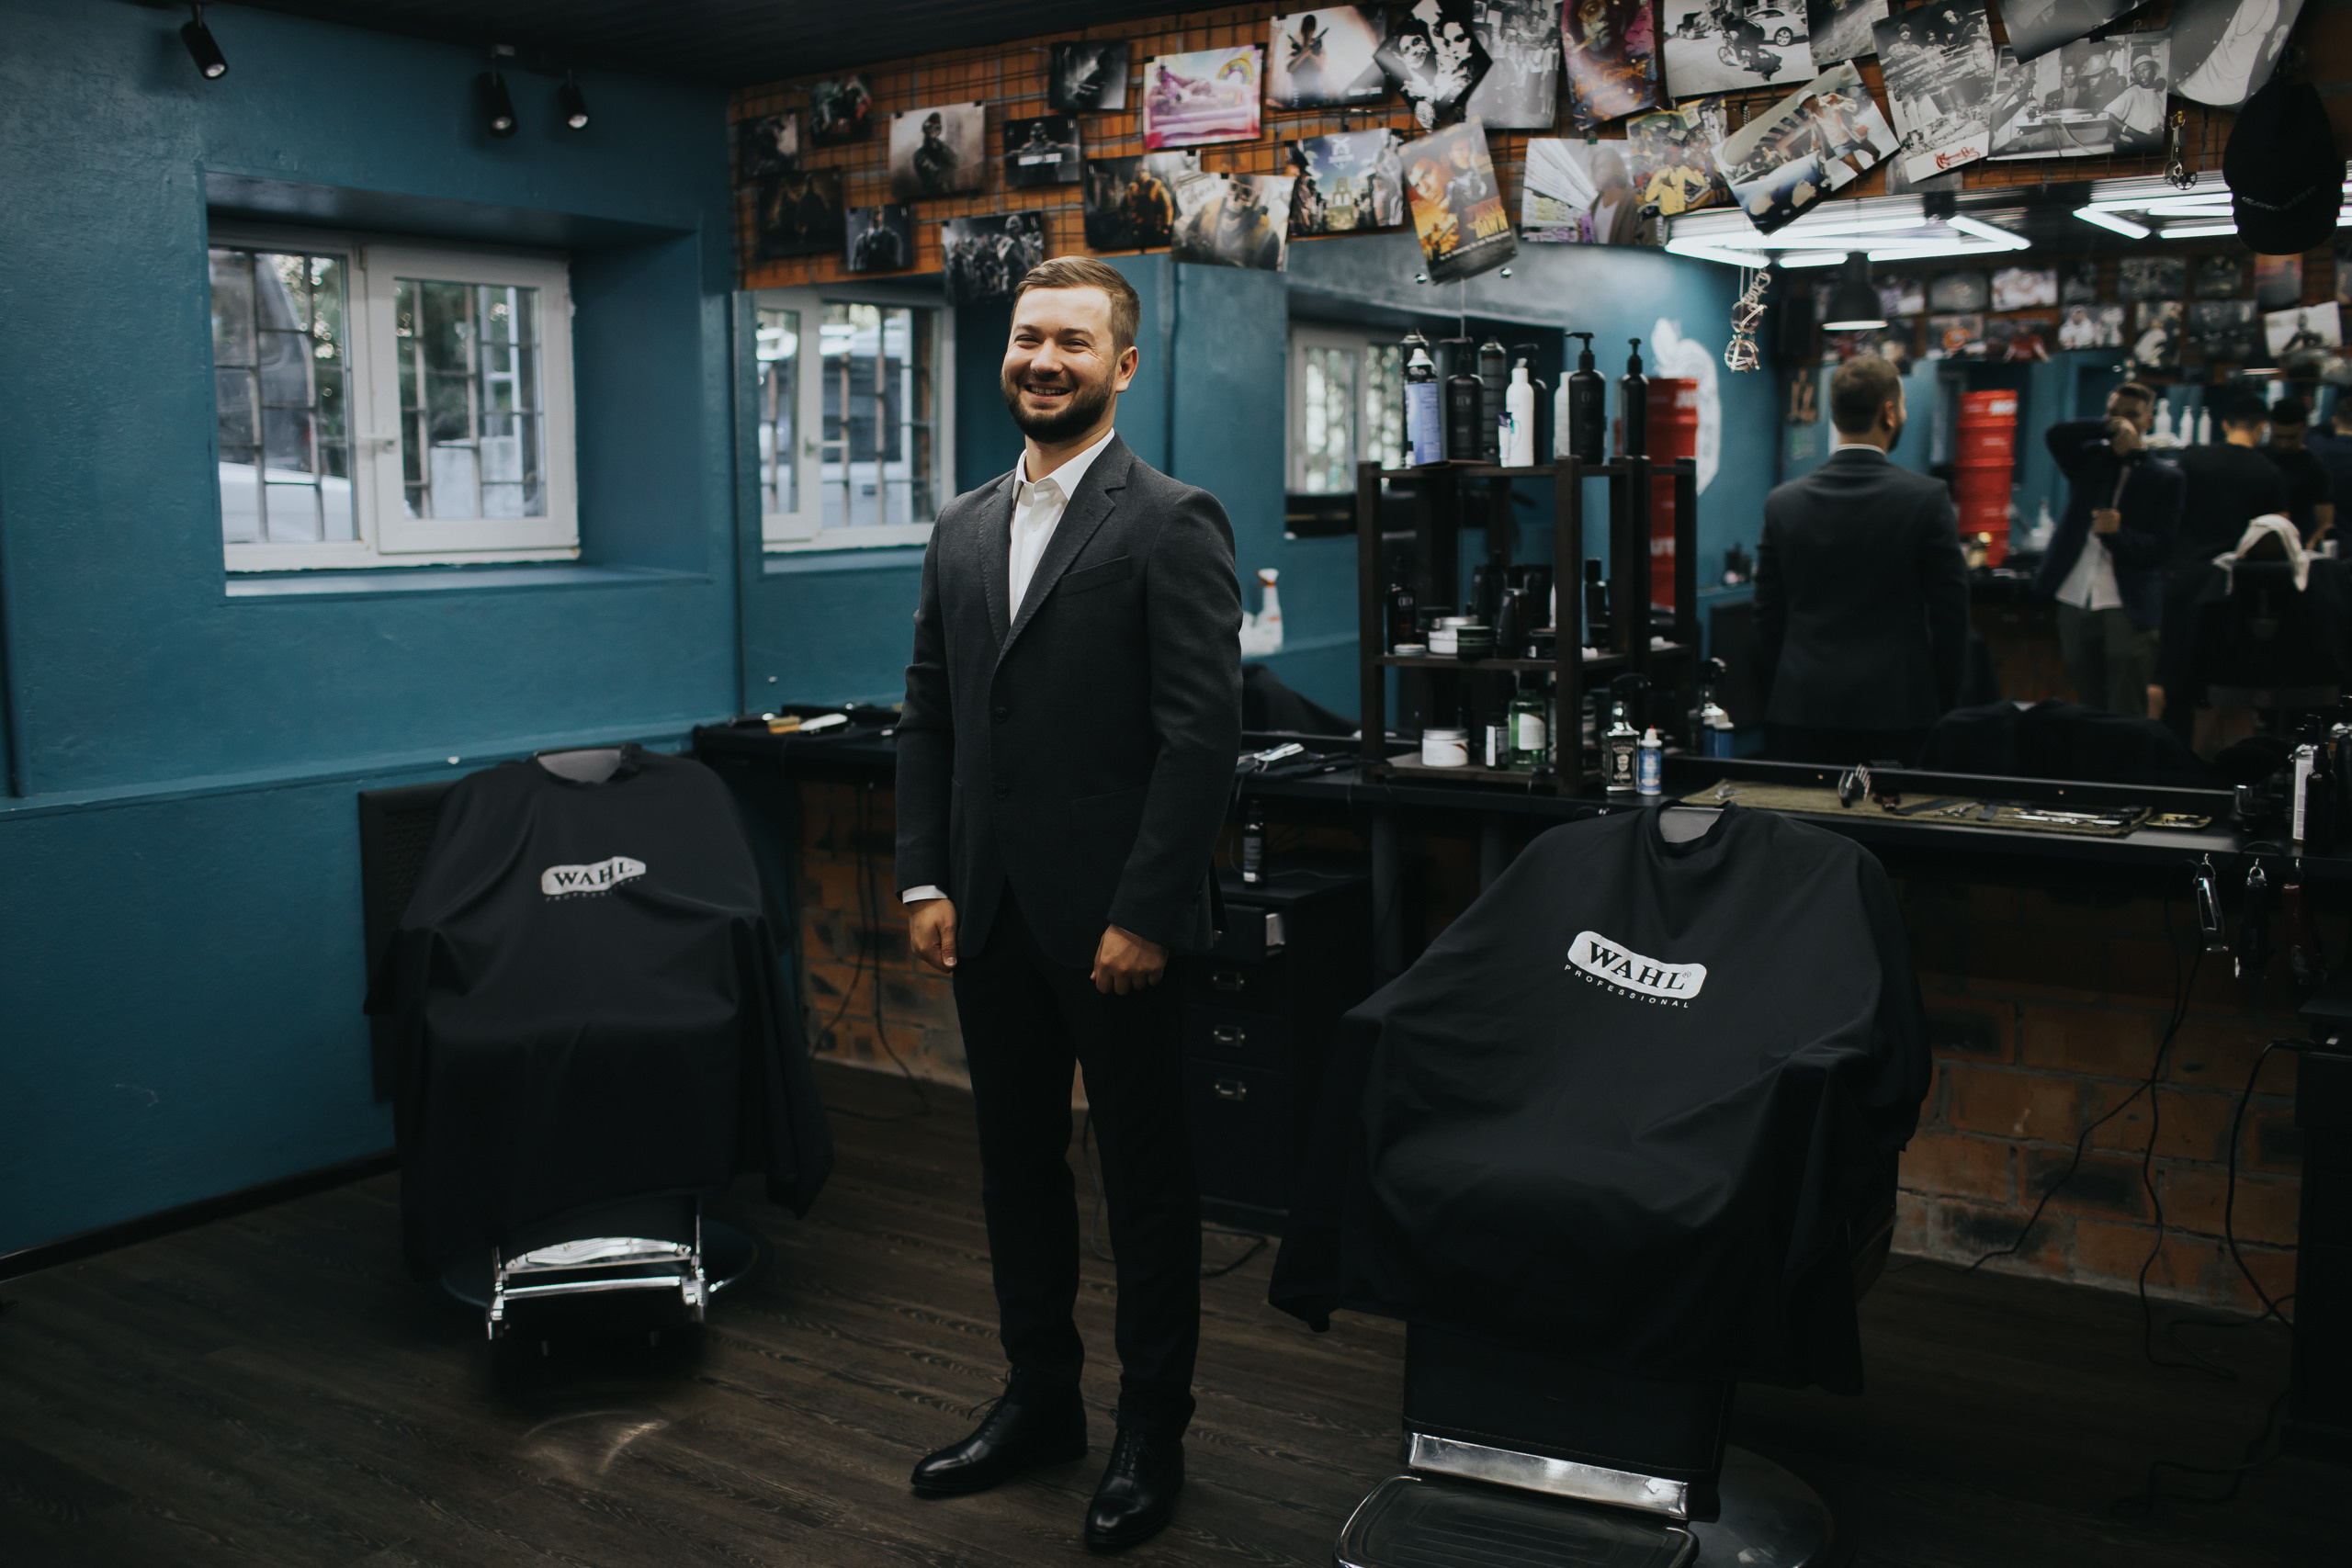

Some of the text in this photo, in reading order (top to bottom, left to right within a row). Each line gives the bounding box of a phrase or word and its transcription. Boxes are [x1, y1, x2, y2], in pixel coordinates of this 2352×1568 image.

[553, 861, 632, 887] WAHL
[1564, 964, 1689, 1009] PROFESSIONAL
[1589, 941, 1686, 990] WAHL
